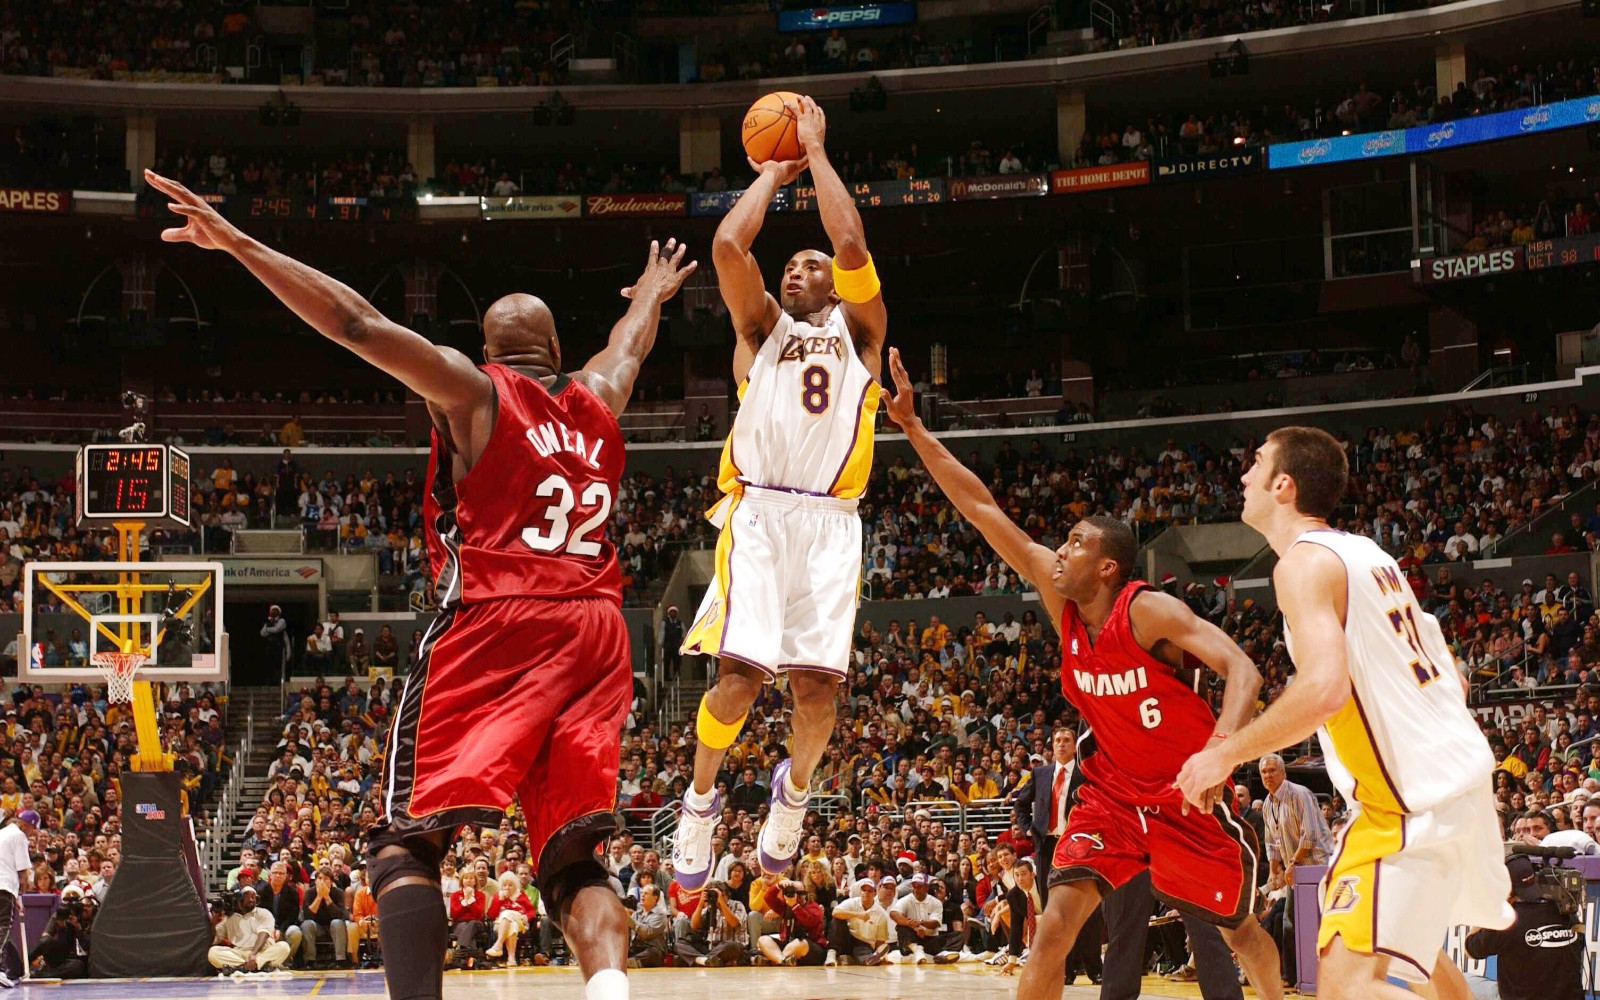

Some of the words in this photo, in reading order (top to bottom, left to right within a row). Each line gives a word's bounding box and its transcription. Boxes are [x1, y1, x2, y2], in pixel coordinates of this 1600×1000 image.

[827, 9, 881, 23] PEPSI
[1179, 155, 1253, 173] DIRECTV
[910, 179, 931, 190] MIA
[967, 180, 1027, 193] McDonald's
[1055, 176, 1078, 188] THE
[1080, 172, 1110, 185] HOME
[1112, 167, 1148, 183] DEPOT
[855, 183, 870, 194] LA
[902, 193, 914, 204] 14
[927, 191, 940, 203] 20
[251, 197, 290, 217] 2:45
[587, 196, 687, 215] Budweiser
[795, 200, 808, 211] FT
[869, 195, 881, 206] 15
[1528, 240, 1553, 253] NBA
[1432, 250, 1515, 280] STAPLES
[1528, 251, 1554, 270] DET
[801, 363, 832, 417] 8
[1525, 392, 1538, 403] 219
[525, 421, 604, 470] ONEAL
[106, 451, 160, 471] 2:45
[115, 478, 149, 510] 15
[520, 473, 613, 558] 32
[238, 566, 248, 578] of
[249, 566, 291, 578] America
[1138, 696, 1163, 730] 6
